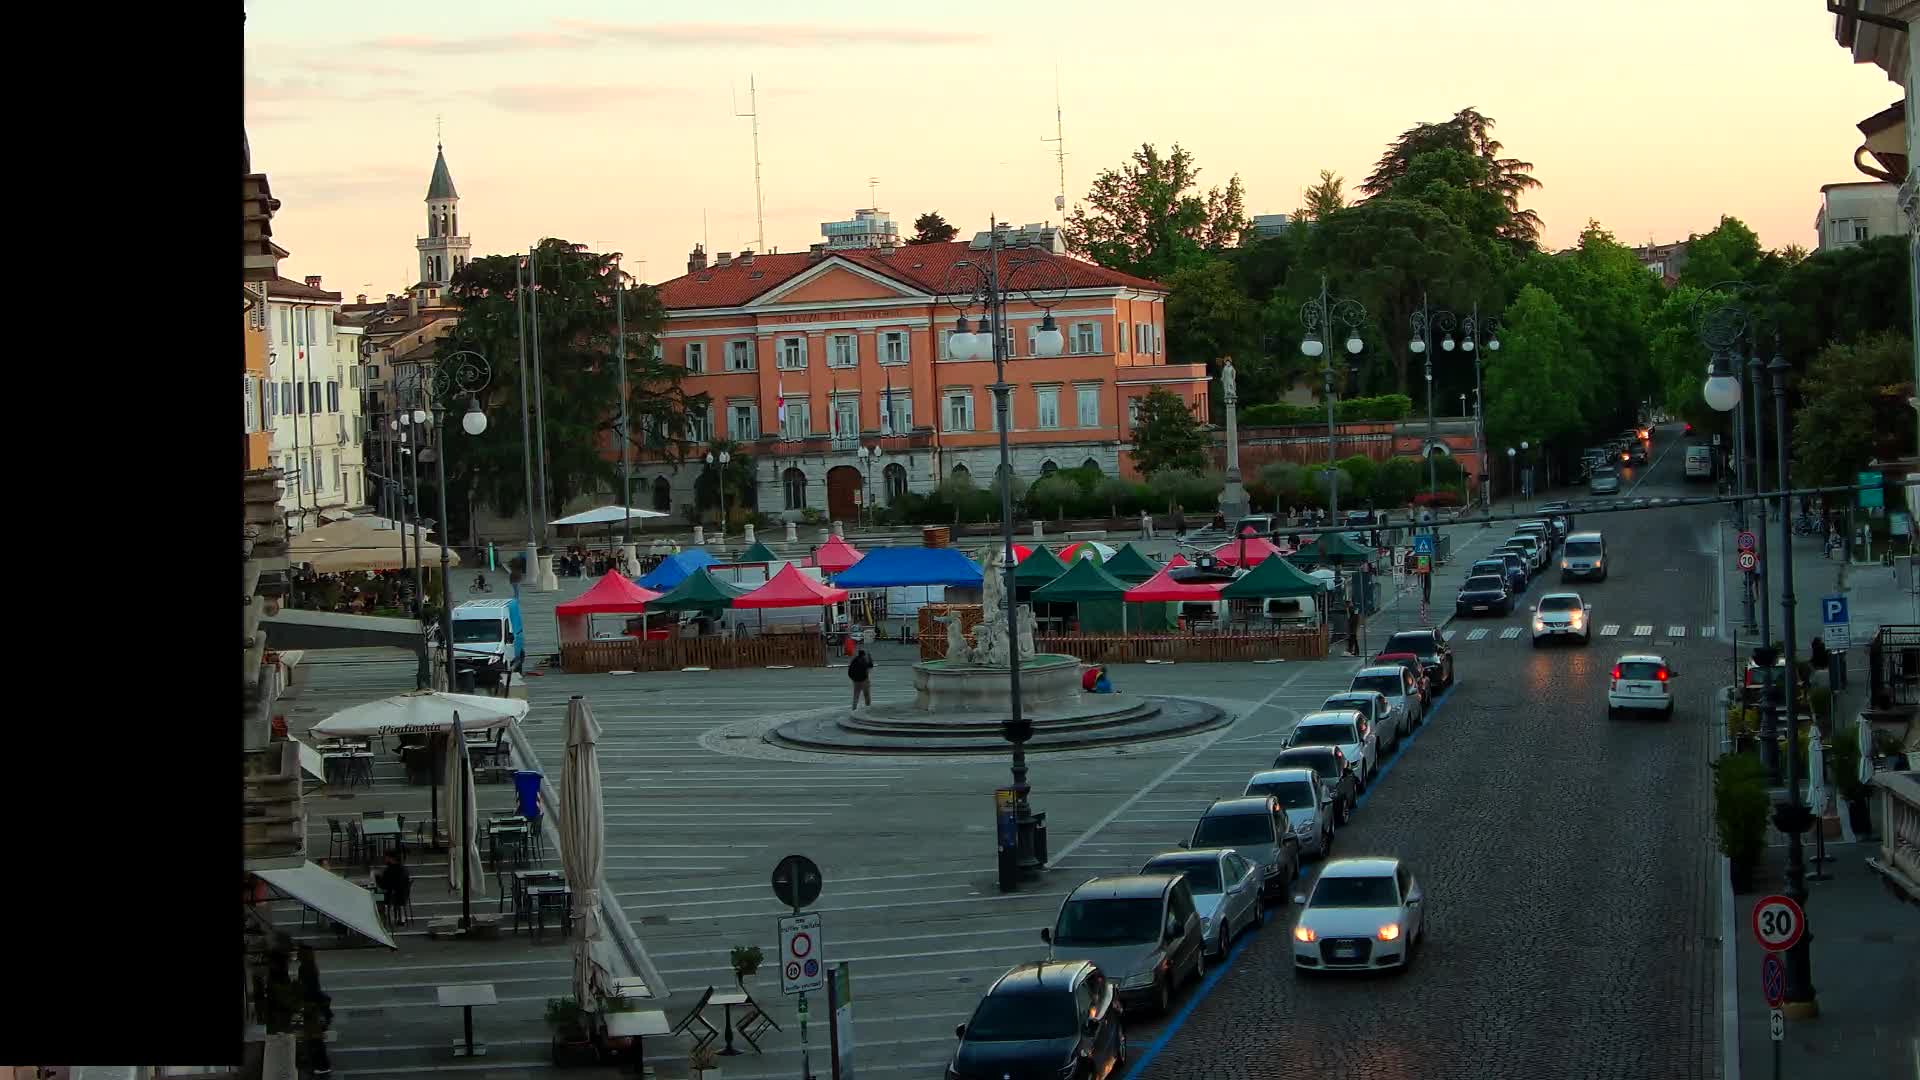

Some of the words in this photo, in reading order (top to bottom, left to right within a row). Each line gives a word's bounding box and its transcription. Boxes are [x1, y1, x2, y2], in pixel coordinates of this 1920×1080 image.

[1742, 556, 1753, 565] 20
[1827, 600, 1843, 621] P
[378, 721, 441, 735] Piadineria
[1762, 910, 1792, 936] 30
